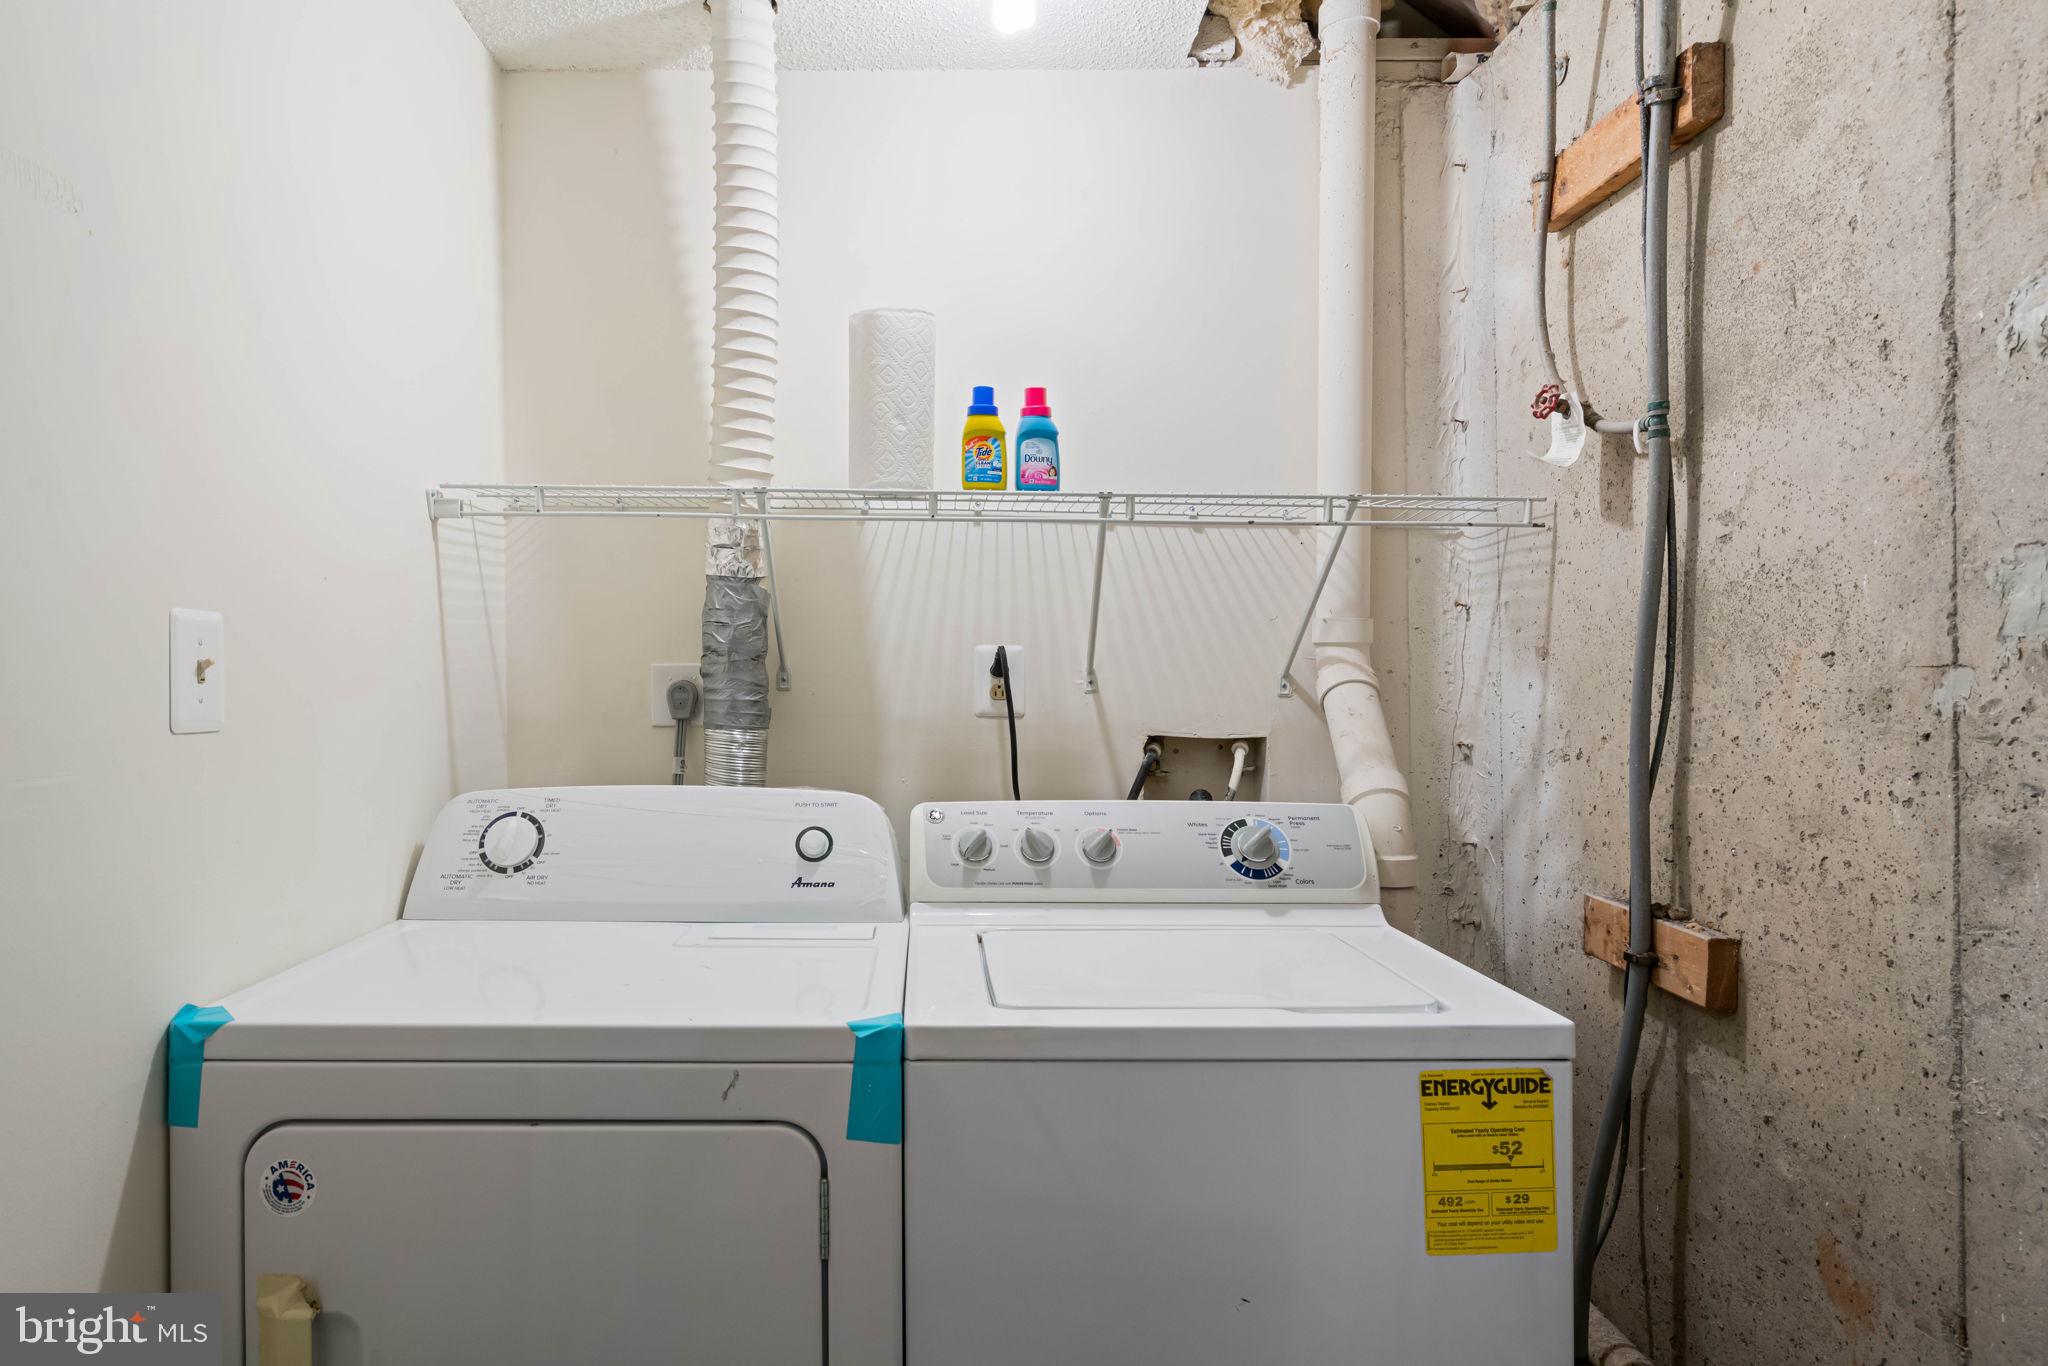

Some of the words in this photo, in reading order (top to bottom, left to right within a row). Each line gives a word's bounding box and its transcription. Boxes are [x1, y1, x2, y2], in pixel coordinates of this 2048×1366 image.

[976, 447, 992, 458] Tide
[1024, 454, 1053, 466] Downy
[790, 877, 835, 888] Amana
[1421, 1077, 1551, 1097] ENERGYGUIDE
[1492, 1141, 1523, 1155] $52
[270, 1160, 315, 1190] AMERICA
[1438, 1196, 1463, 1206] 492
